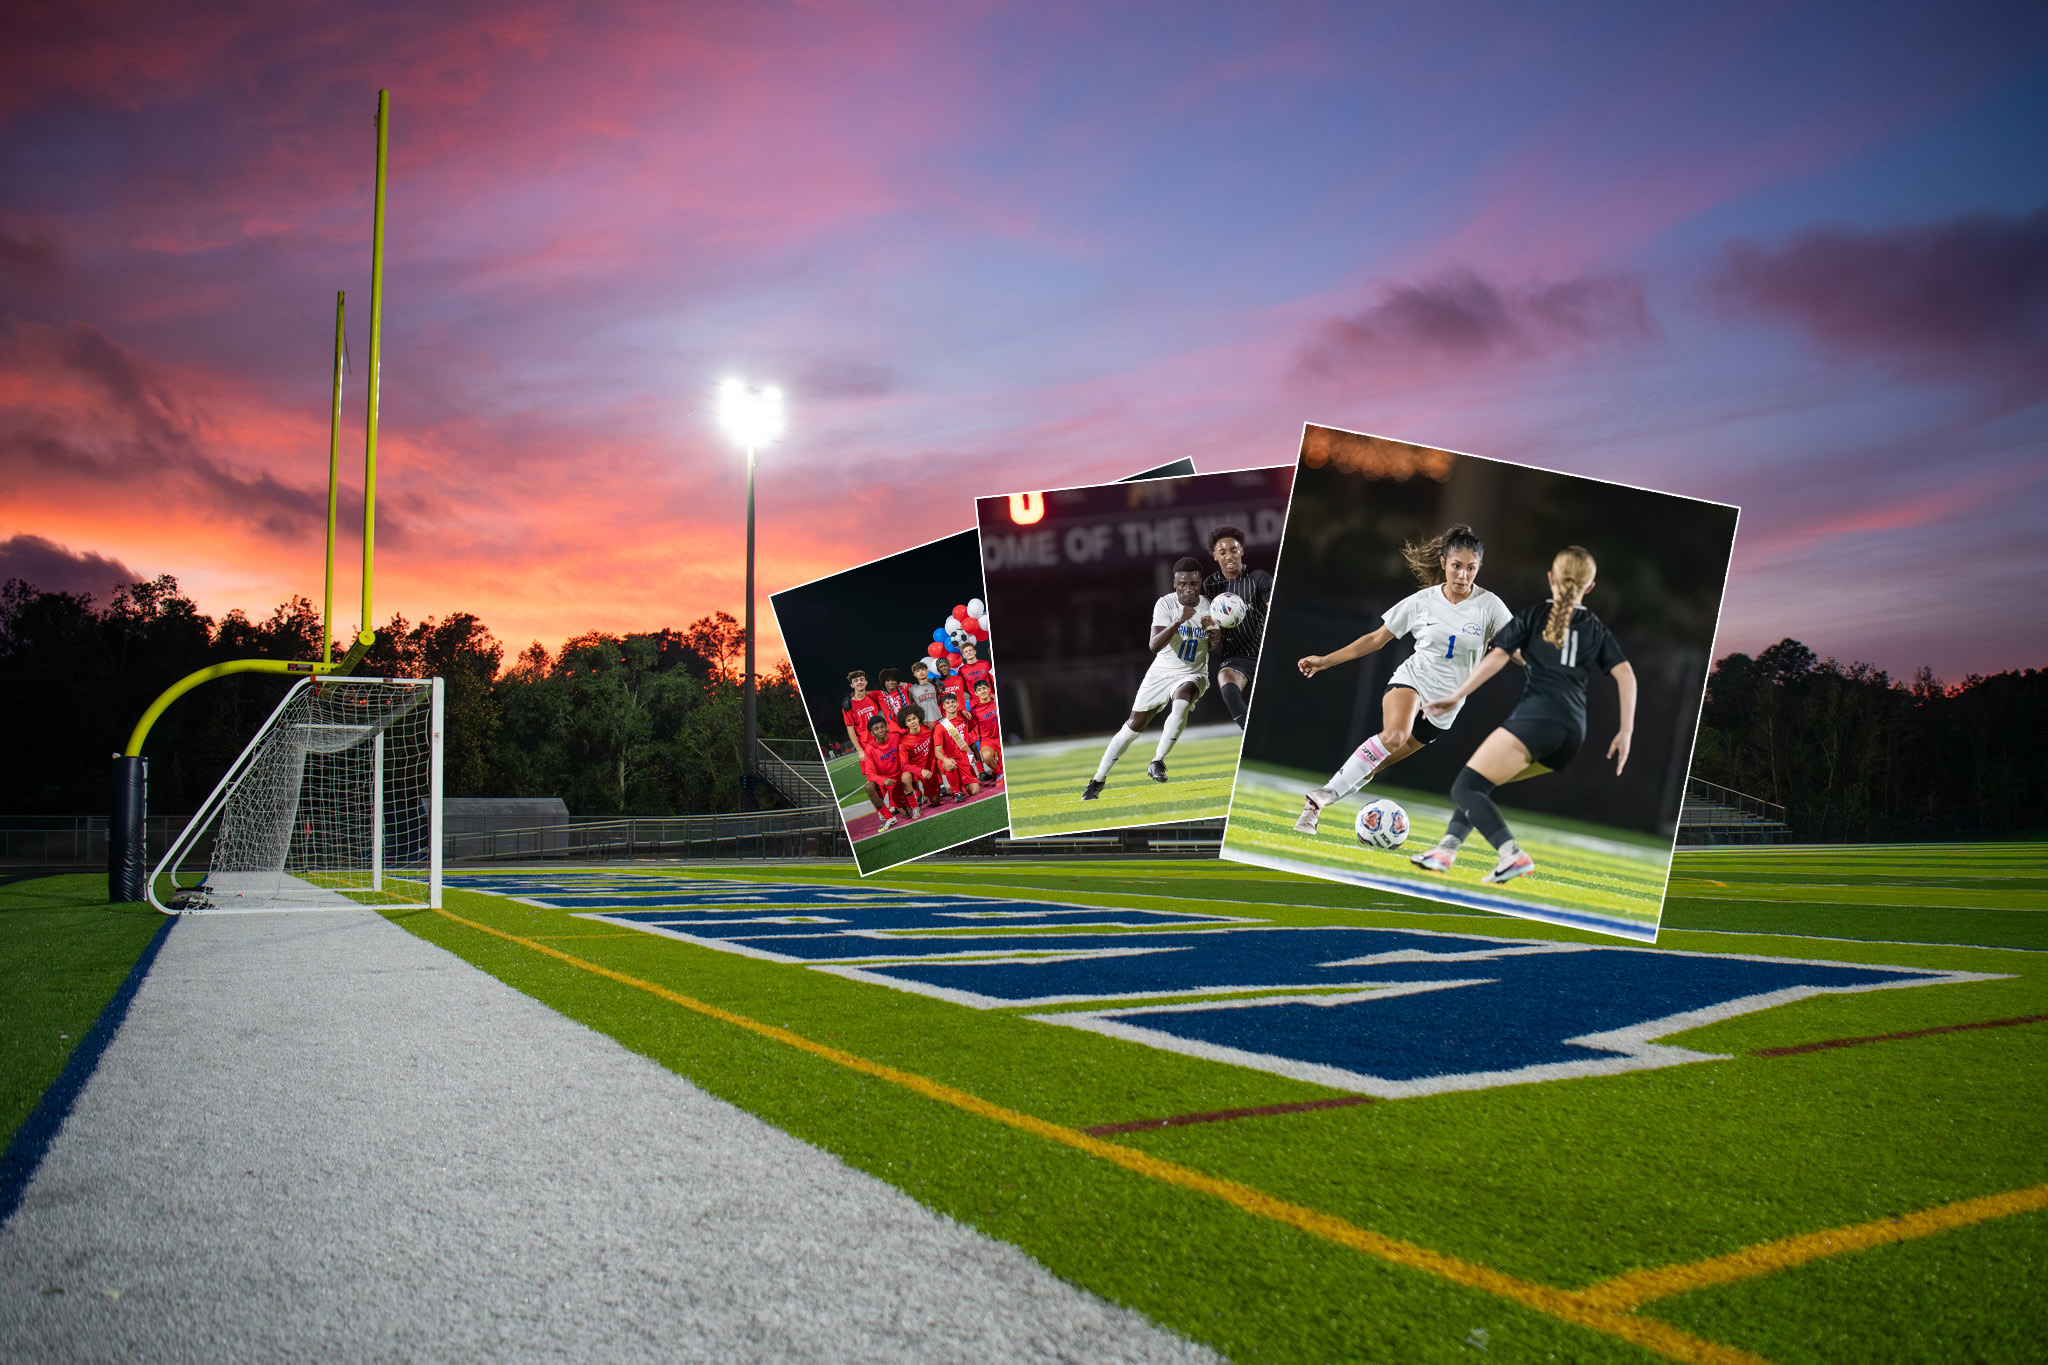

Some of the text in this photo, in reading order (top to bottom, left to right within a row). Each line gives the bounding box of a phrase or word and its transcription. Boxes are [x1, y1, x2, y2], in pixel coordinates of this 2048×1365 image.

[1065, 524, 1113, 564] OF
[1120, 515, 1191, 558] THE
[1177, 639, 1198, 662] 10
[1445, 634, 1456, 659] 1
[1560, 627, 1579, 668] 11
